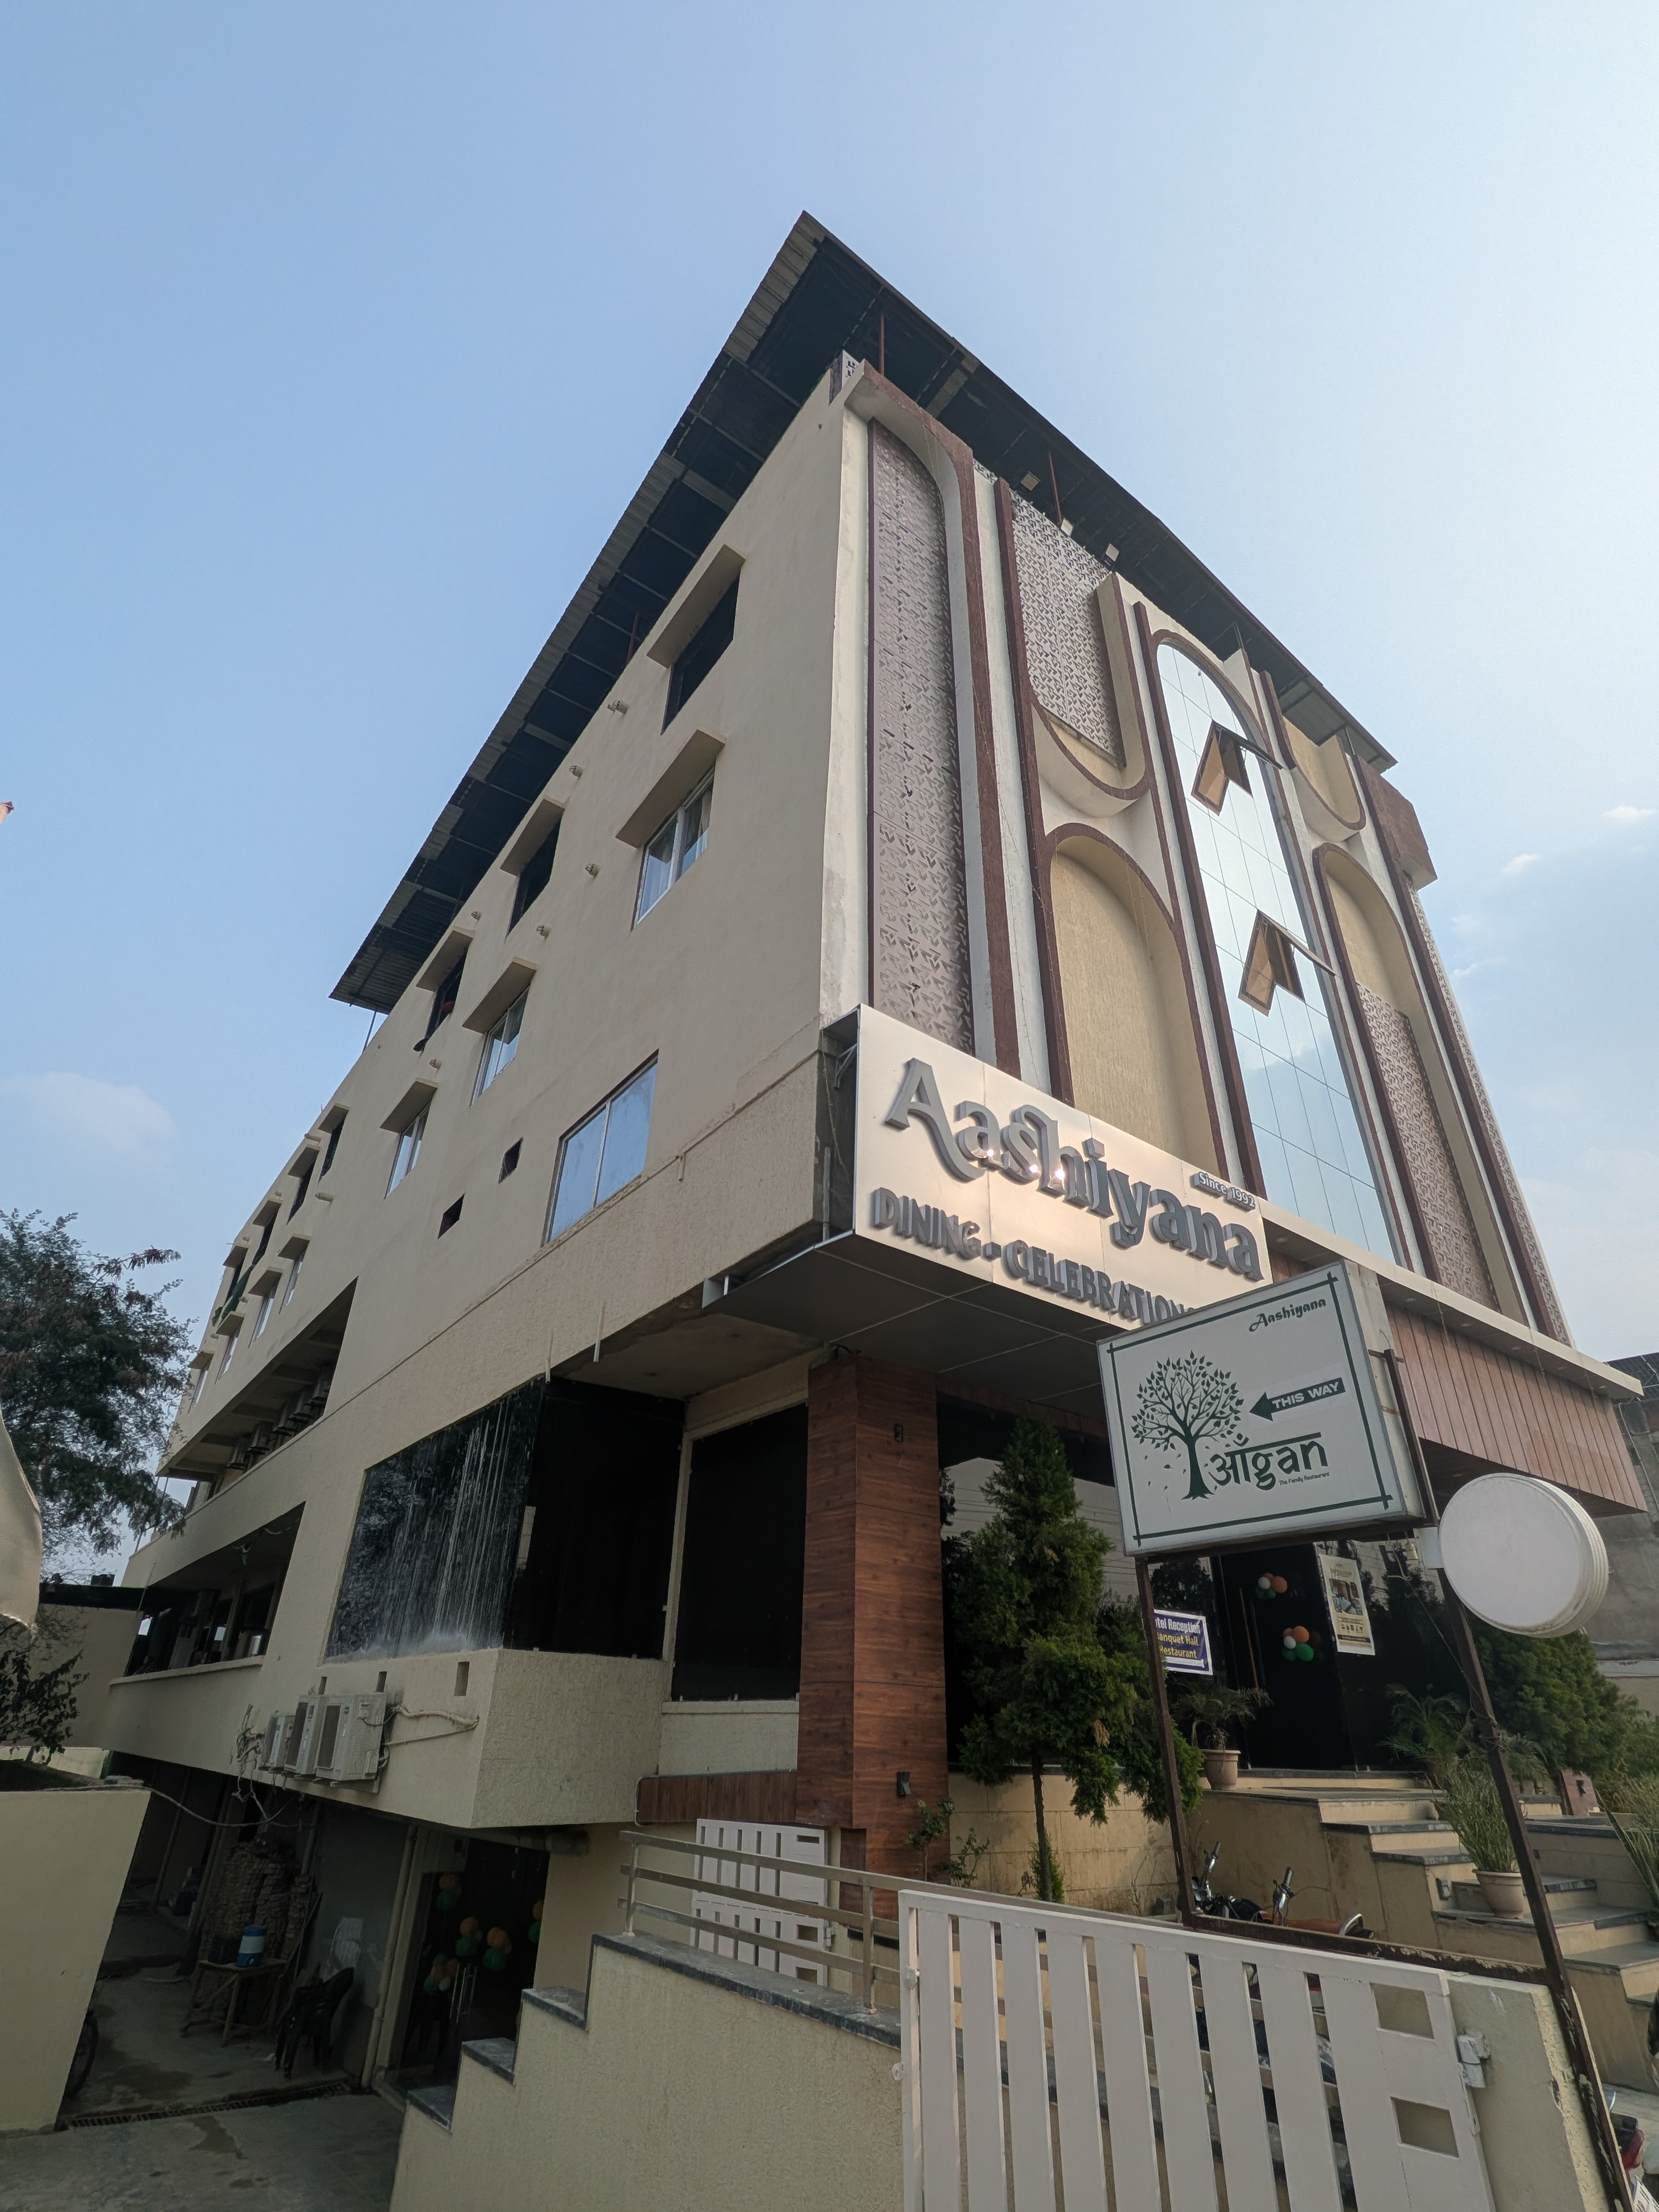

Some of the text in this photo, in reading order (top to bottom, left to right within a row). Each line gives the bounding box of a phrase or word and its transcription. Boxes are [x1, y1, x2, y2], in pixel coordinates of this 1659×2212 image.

[885, 1058, 1264, 1281] Aashiyana
[1198, 1172, 1255, 1208] Since 1992
[873, 1187, 982, 1259] DINING
[1005, 1240, 1194, 1324] CELEBRATIO
[1249, 1298, 1327, 1332] Aashiyana
[1272, 1381, 1339, 1409] THIS WAY
[1303, 1472, 1331, 1481] Restaurant
[1168, 1619, 1201, 1634] Reception
[1185, 1635, 1198, 1646] Hall
